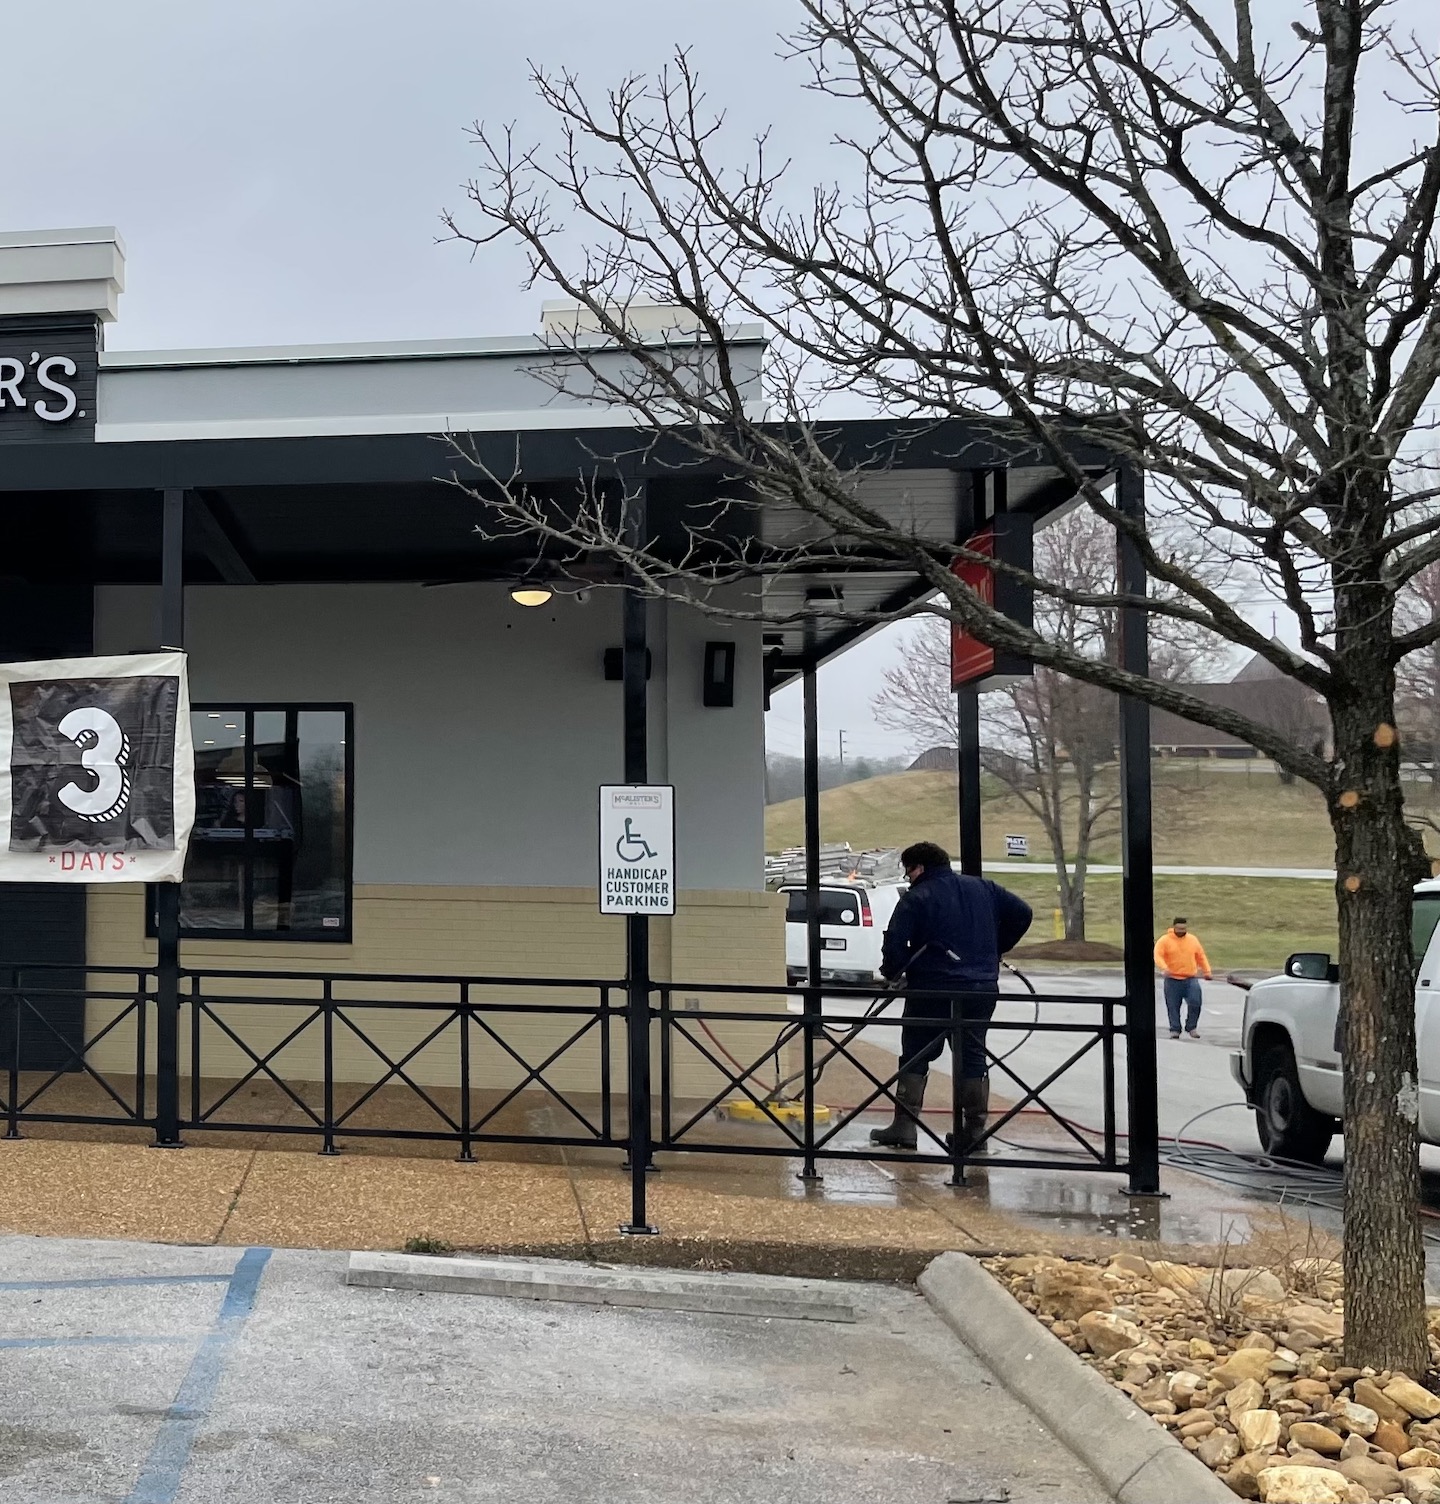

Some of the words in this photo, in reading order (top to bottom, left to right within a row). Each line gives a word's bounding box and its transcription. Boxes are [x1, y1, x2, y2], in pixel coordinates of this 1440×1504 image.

[57, 706, 130, 822] 3
[60, 851, 126, 871] DAYS
[607, 868, 667, 880] HANDICAP
[606, 881, 669, 893] CUSTOMER
[606, 895, 669, 906] PARKING
